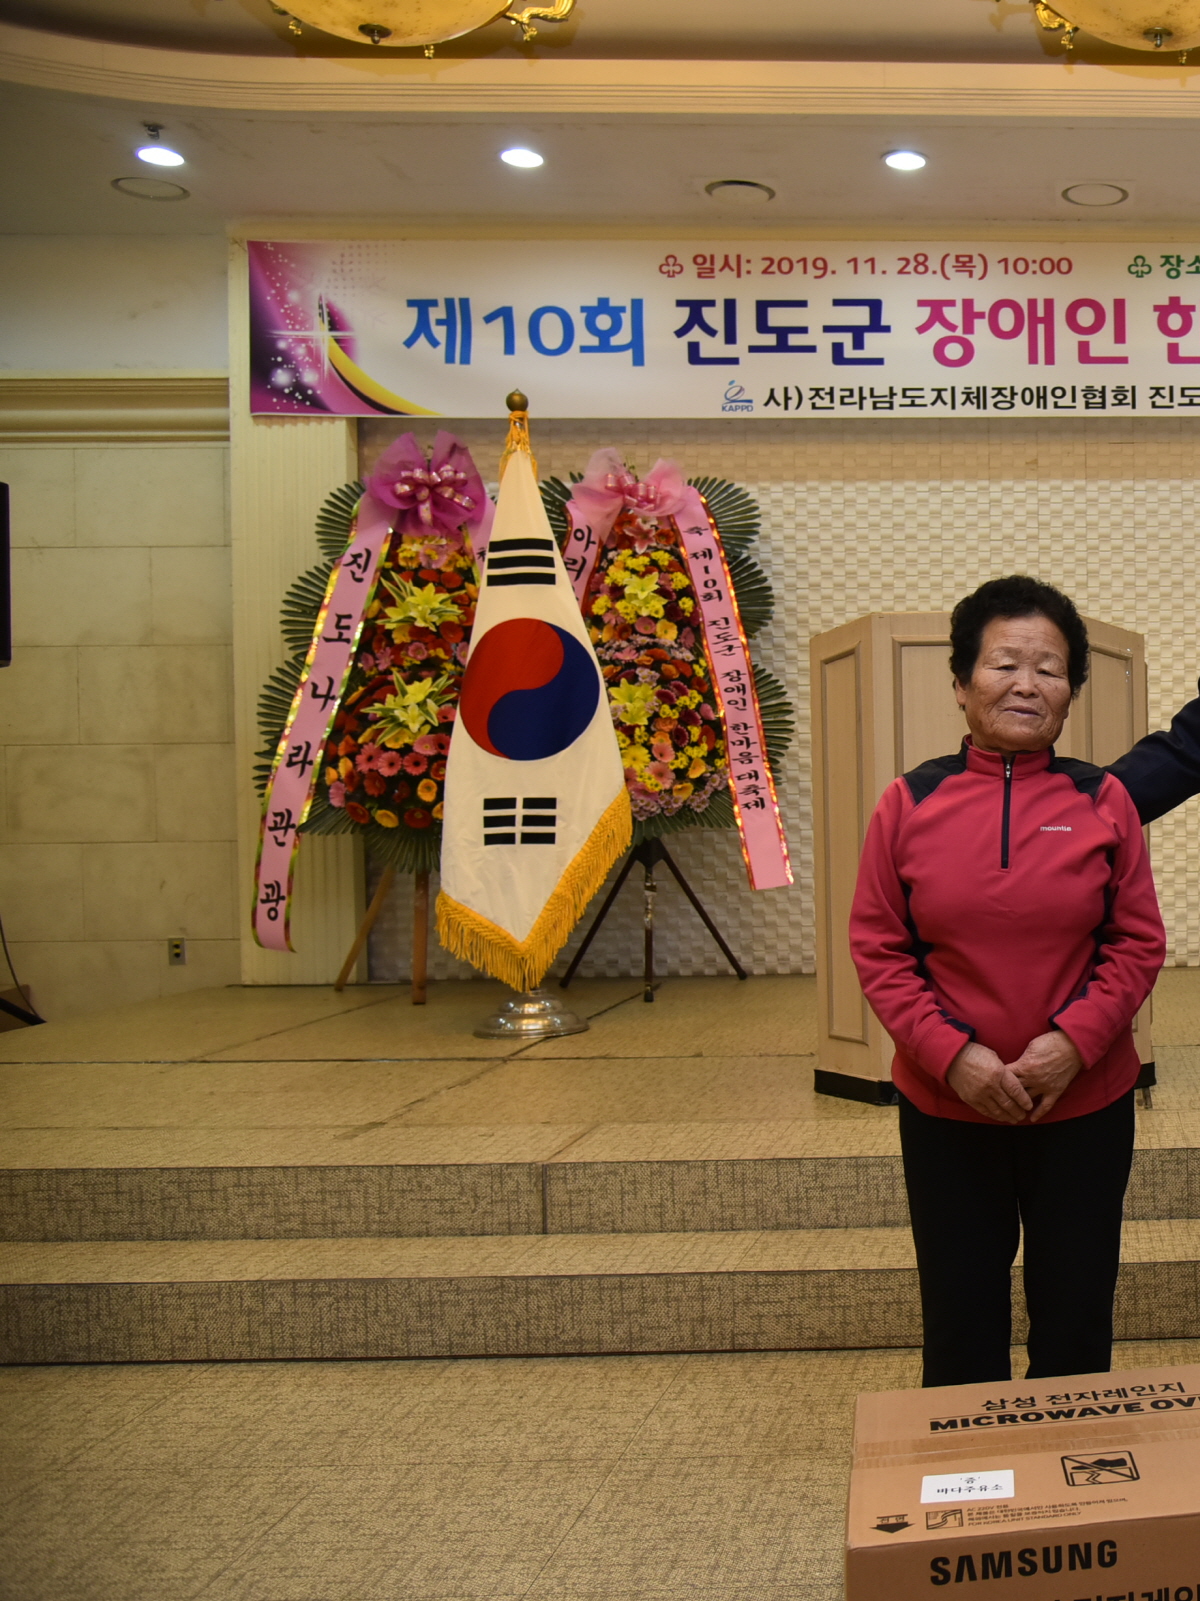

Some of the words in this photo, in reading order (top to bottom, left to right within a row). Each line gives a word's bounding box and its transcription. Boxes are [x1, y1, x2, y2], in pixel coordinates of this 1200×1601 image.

[692, 253, 752, 279] 일시:
[761, 256, 837, 279] 2019.
[847, 256, 887, 276] 11.
[997, 256, 1073, 276] 10:00
[403, 297, 645, 367] 제10회
[673, 297, 892, 367] 진도군
[915, 297, 1128, 368] 장애인
[763, 385, 1137, 411] 사)전라남도지체장애인협회
[708, 616, 742, 657] 진도군
[719, 669, 748, 712] 장애인
[981, 1396, 1037, 1411] 삼성
[1046, 1382, 1186, 1406] 전자레인지
[930, 1401, 1144, 1431] MICROWAVE
[930, 1540, 1118, 1586] SAMSUNG
